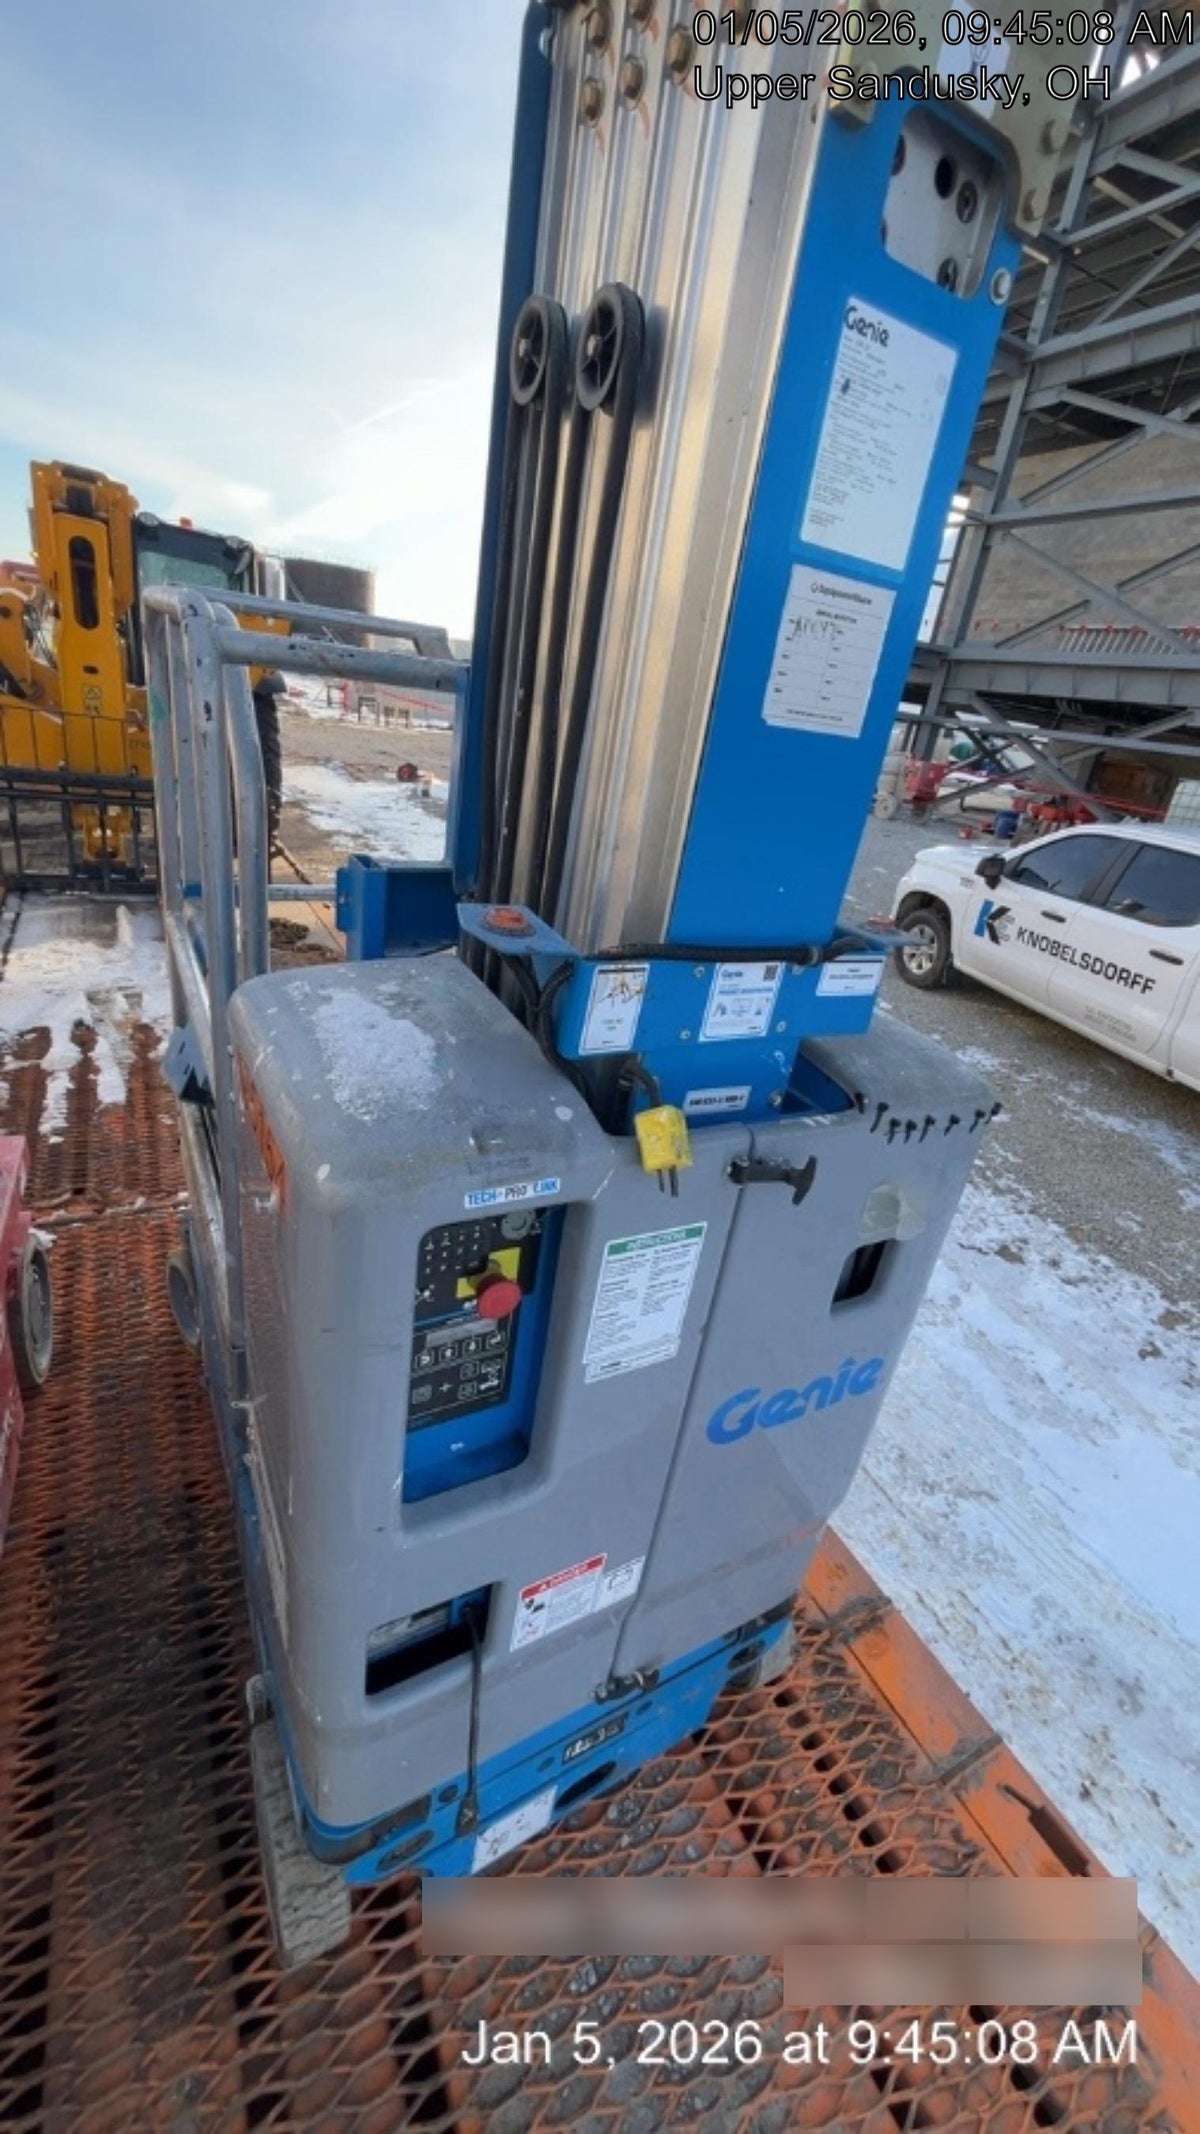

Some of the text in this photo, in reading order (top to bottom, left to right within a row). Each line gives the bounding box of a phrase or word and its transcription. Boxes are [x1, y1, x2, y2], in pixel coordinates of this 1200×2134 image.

[843, 304, 891, 348] Genie
[1016, 925, 1157, 995] KNOBELSDORFF
[705, 1356, 885, 1445] Genie
